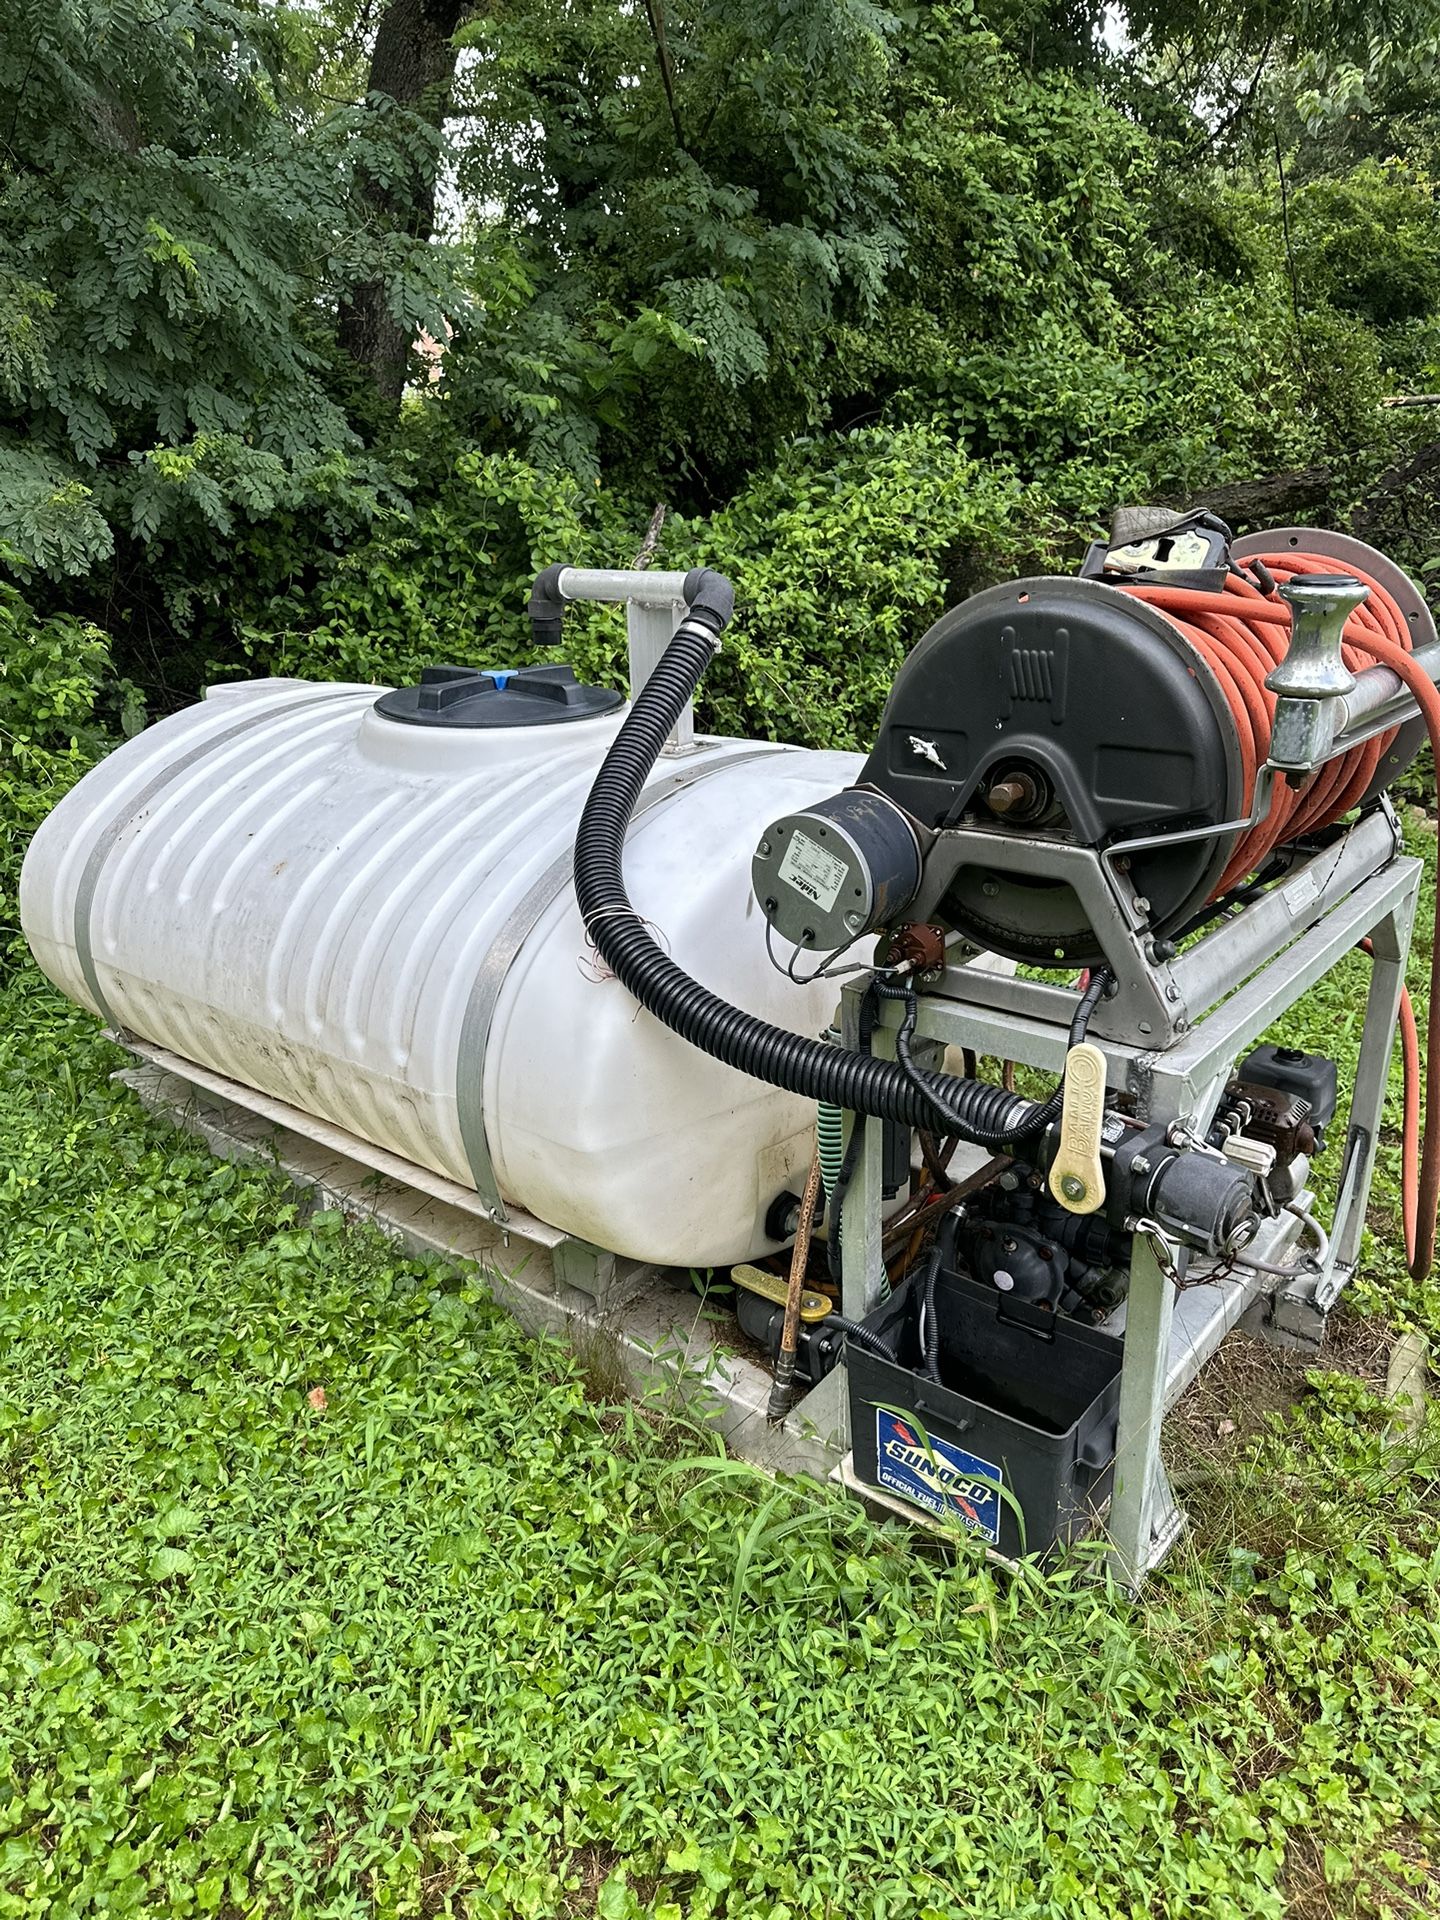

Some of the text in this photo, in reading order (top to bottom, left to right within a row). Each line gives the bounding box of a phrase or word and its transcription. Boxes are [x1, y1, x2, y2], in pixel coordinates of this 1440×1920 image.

[788, 873, 821, 900] Nidec
[1067, 1054, 1099, 1158] BANJO
[882, 1472, 916, 1497] OFFICIAL
[917, 1491, 938, 1510] FUEL
[888, 1442, 987, 1502] SUNOCO
